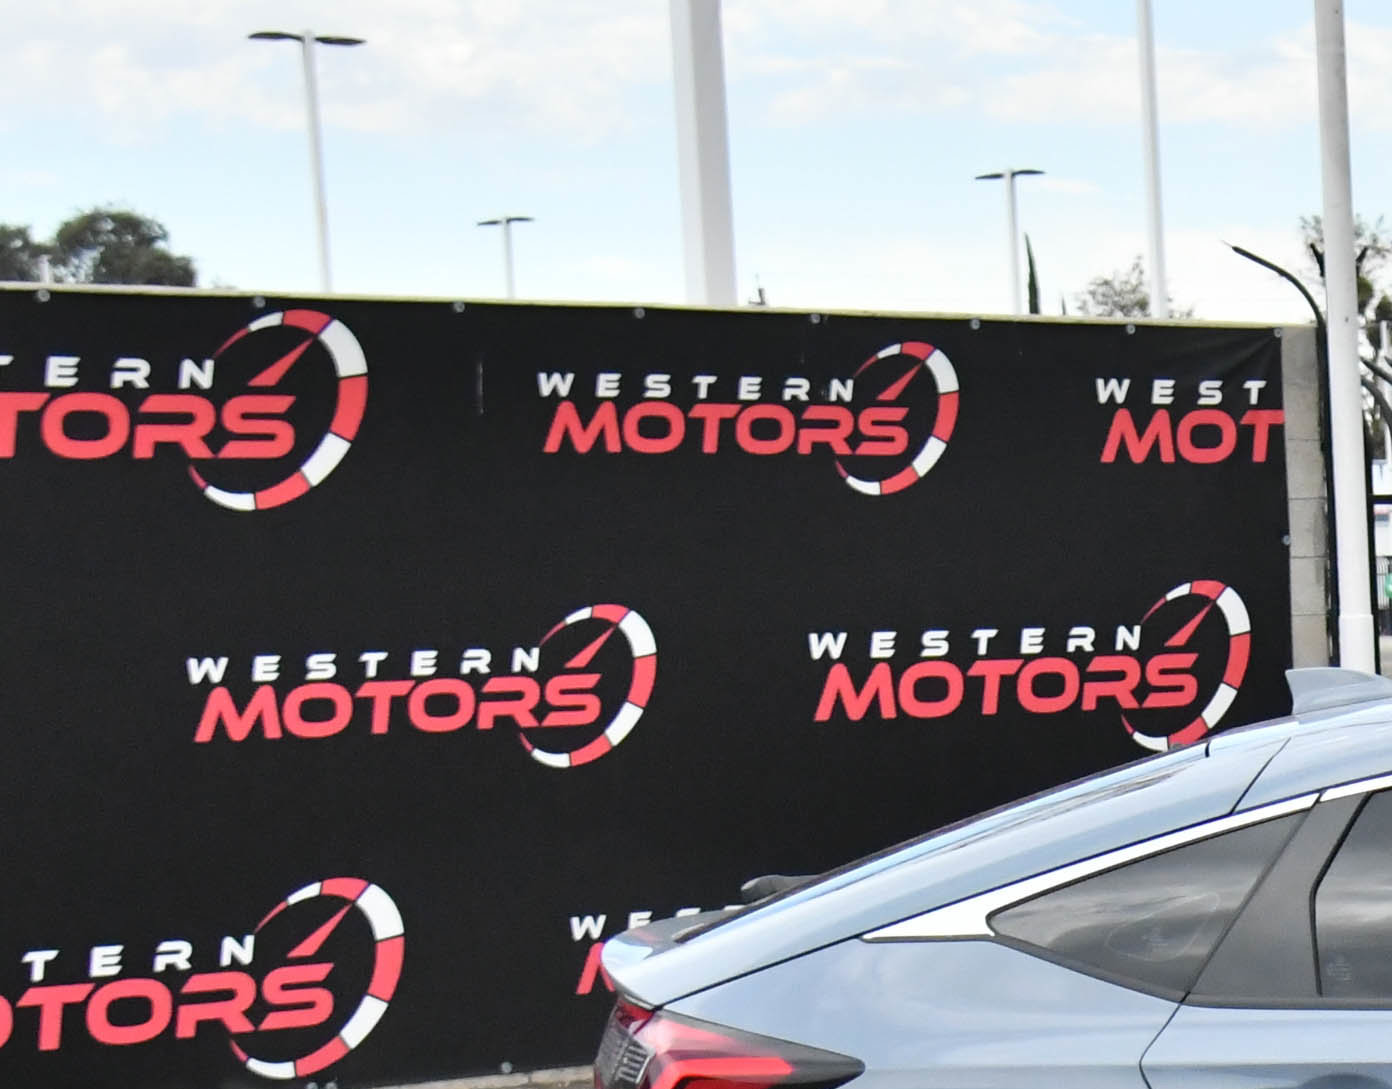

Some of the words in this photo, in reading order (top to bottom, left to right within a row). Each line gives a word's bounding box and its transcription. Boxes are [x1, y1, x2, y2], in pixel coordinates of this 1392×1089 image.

[0, 355, 214, 389] ERN
[538, 373, 854, 402] WESTERN
[1097, 378, 1267, 405] WEST
[543, 401, 909, 456] MOTORS
[808, 625, 1141, 660] WESTERN
[187, 648, 540, 684] WESTERN
[814, 653, 1199, 722] MOTORS
[195, 674, 601, 743] MOTORS
[0, 962, 335, 1051] TORS
